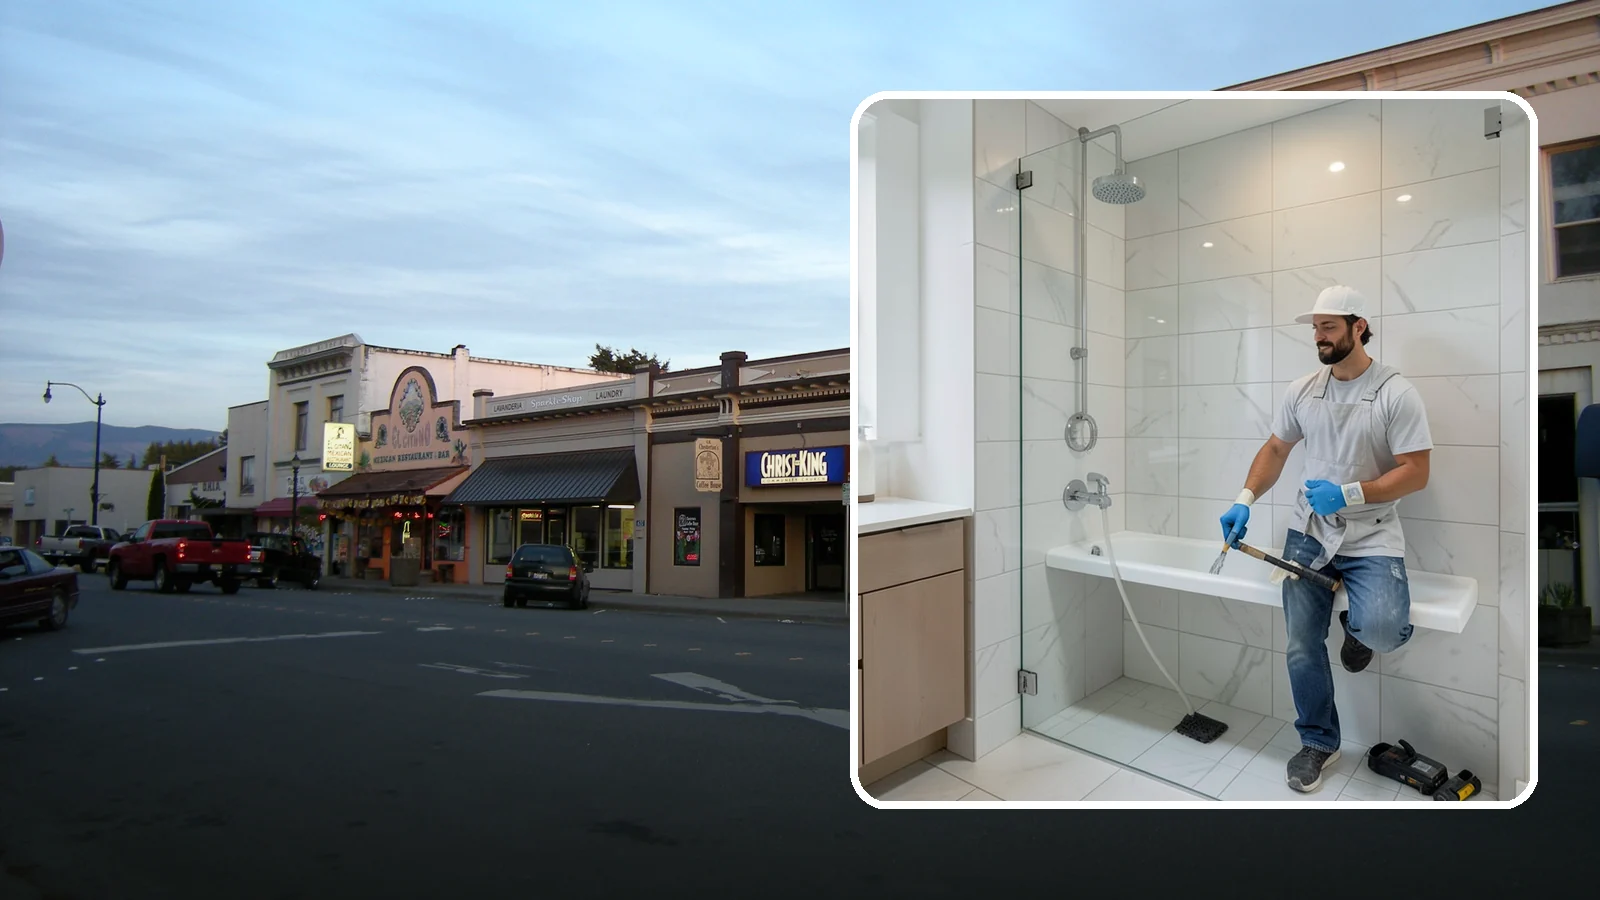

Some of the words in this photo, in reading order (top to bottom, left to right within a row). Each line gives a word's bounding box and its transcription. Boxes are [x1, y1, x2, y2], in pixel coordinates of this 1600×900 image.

[595, 389, 623, 400] LAUNDRY
[493, 402, 522, 412] LAVANDERIA
[373, 455, 396, 464] MEXICAN
[397, 451, 433, 462] RESTAURANT
[437, 450, 450, 460] BAR
[761, 452, 797, 478] CHRIST
[799, 450, 827, 476] KING
